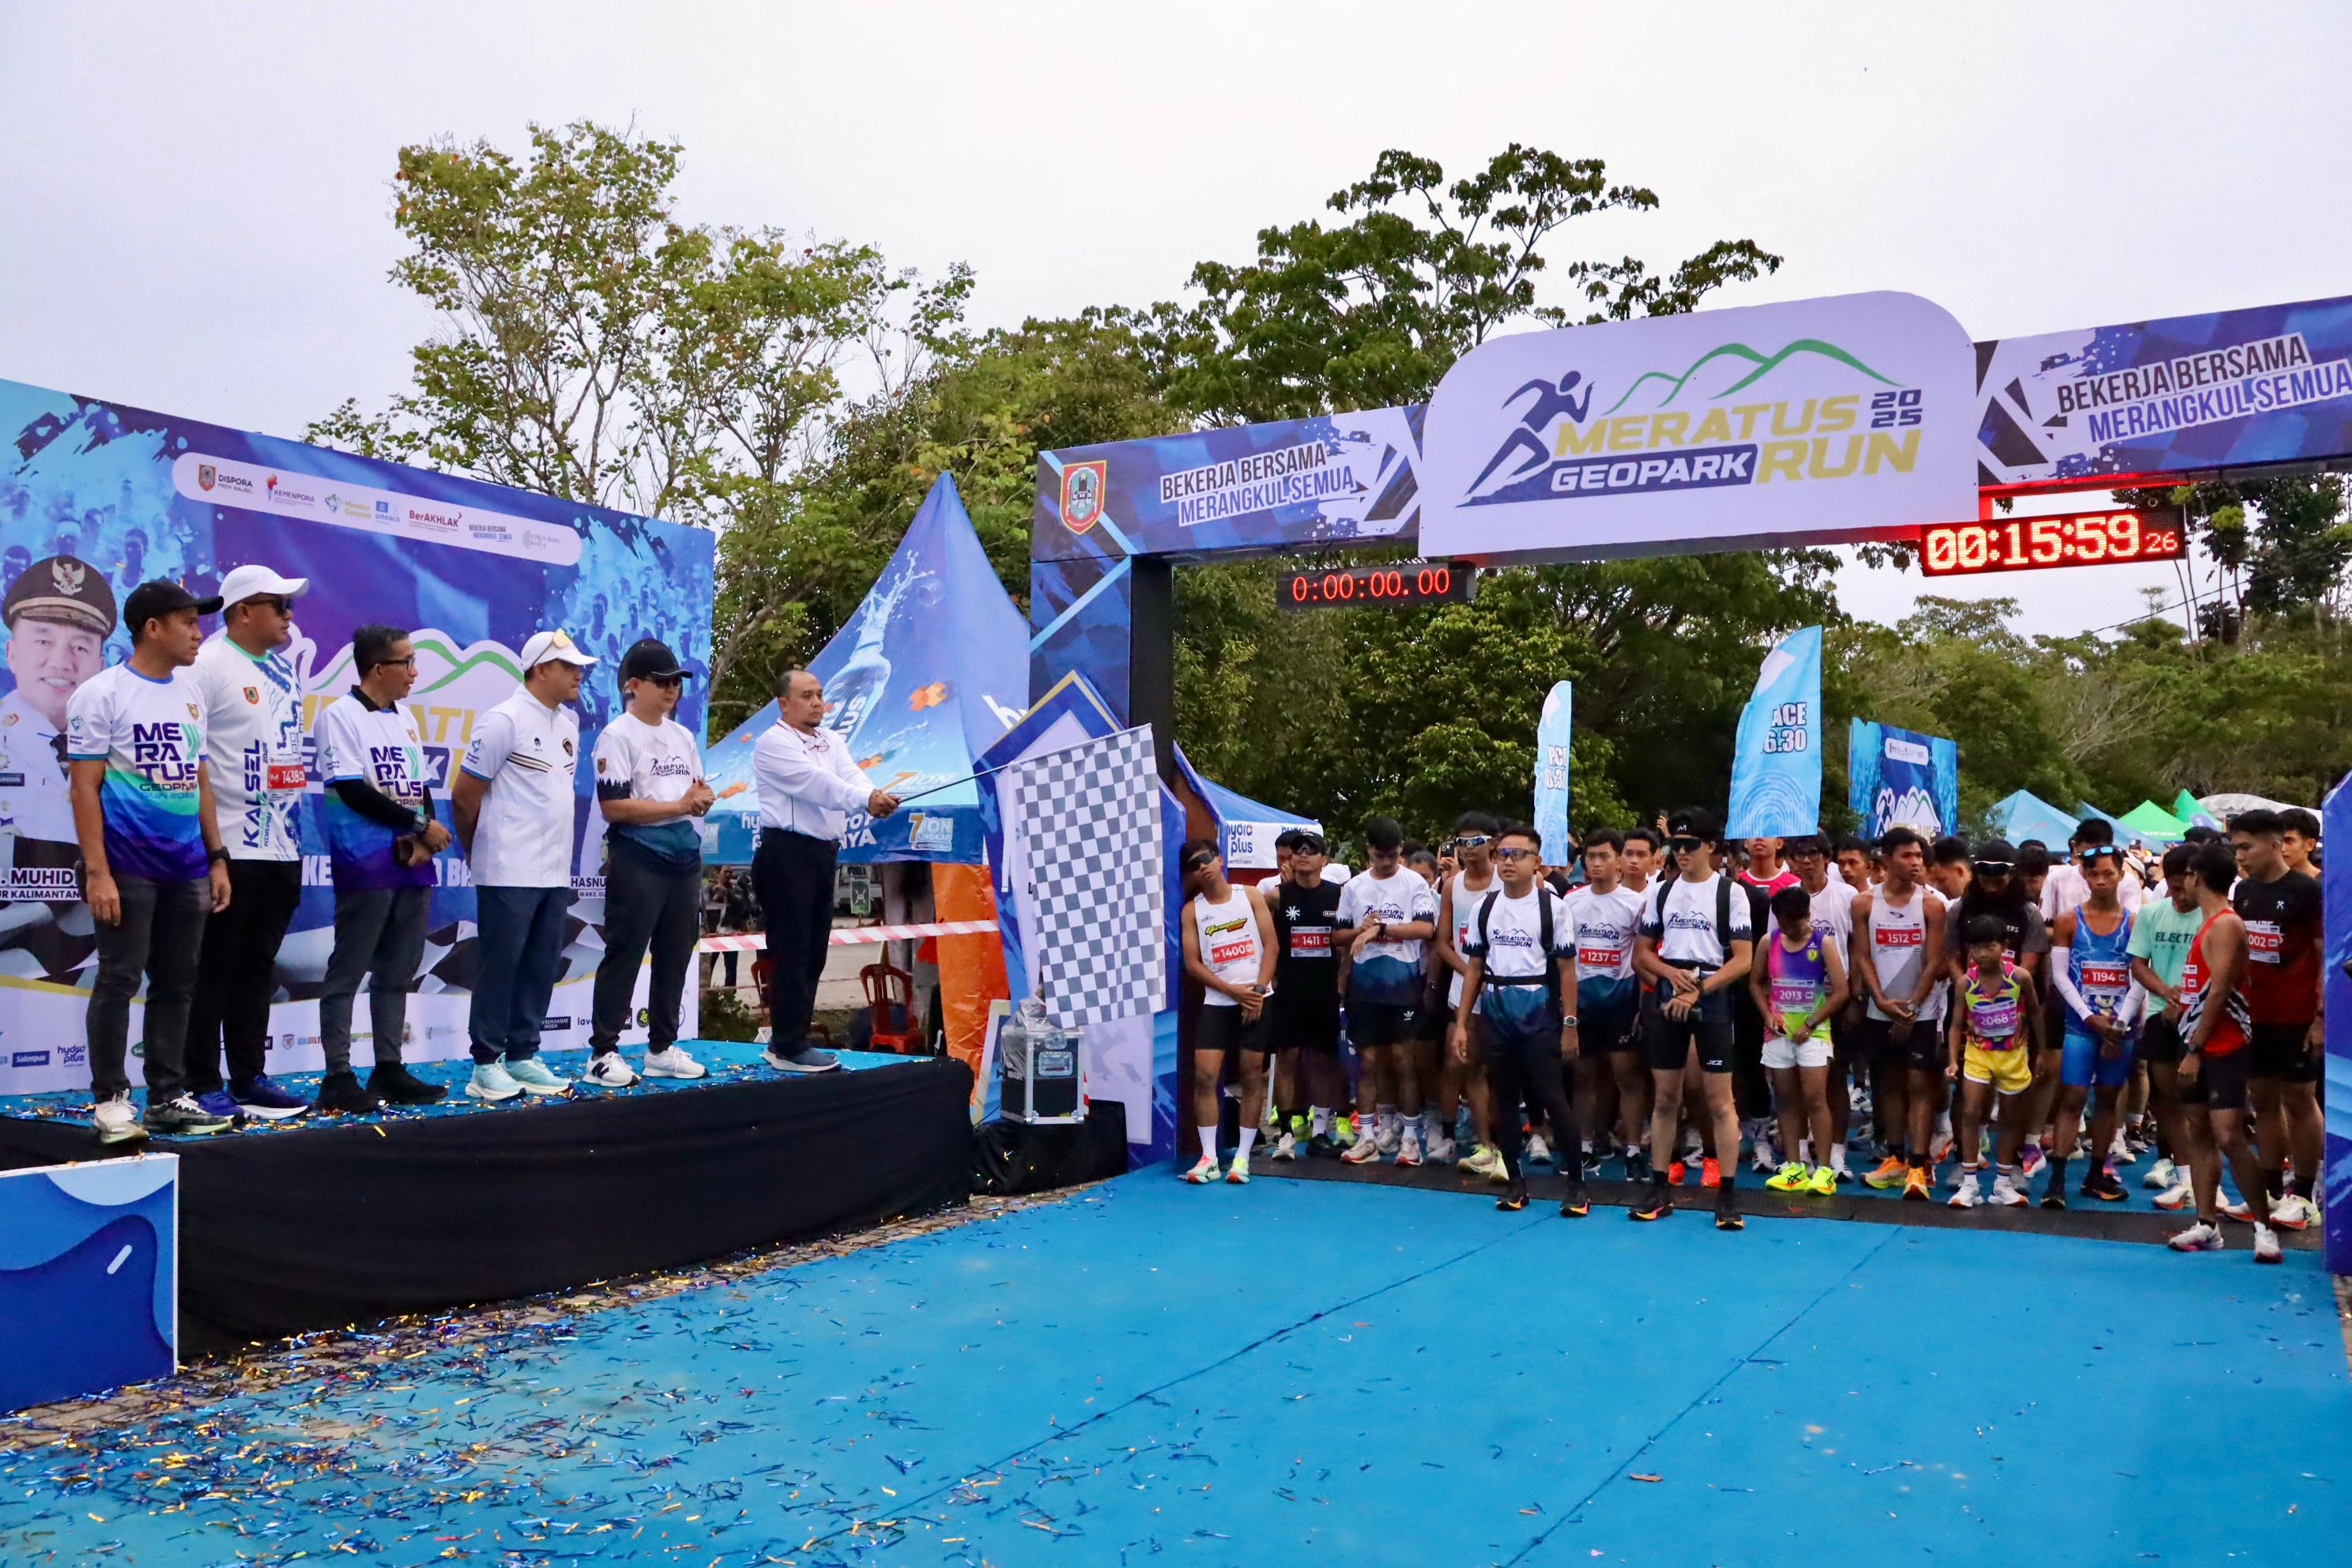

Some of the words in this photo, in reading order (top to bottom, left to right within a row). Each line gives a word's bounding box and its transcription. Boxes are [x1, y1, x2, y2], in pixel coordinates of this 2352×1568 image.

[2058, 366, 2172, 413] BEKERJA
[2177, 334, 2308, 390] BERSAMA
[1870, 389, 1922, 410] 20
[2088, 389, 2253, 444] MERANGKUL
[2256, 364, 2352, 409] SEMUA
[1554, 394, 1860, 458] MERATUS
[1870, 409, 1923, 429] 25
[1756, 428, 1920, 484] RUN
[1163, 462, 1236, 501] BEKERJA
[1241, 444, 1327, 483] BERSAMA
[1551, 452, 1752, 492] GEOPARK
[217, 474, 253, 488] DISPORA
[273, 489, 315, 503] KEMENPORA
[1180, 485, 1287, 526] MERANGKUL
[1289, 466, 1355, 501] SEMUA
[375, 514, 401, 522] unesco
[409, 510, 459, 527] BerAKHLAK
[1926, 514, 2141, 571] 00:15:59
[2144, 530, 2178, 554] 26
[133, 722, 183, 743] ME
[134, 743, 182, 763] RA
[370, 746, 405, 763] ME
[135, 763, 198, 782] TUS
[282, 770, 300, 784] 1438
[375, 763, 407, 780] RA
[243, 739, 261, 848] KALSEL
[379, 780, 423, 797] TUS
[263, 812, 273, 847] KORPRI
[1231, 839, 1253, 856] plus
[11, 870, 75, 885] MUHID
[571, 876, 606, 890] HASNU
[10, 890, 81, 899] KALIMANTAN
[1302, 936, 1320, 945] 1411
[1886, 933, 1909, 944] 1512
[2247, 934, 2267, 948] 002
[1220, 945, 1246, 958] 1400
[1587, 952, 1609, 962] 1237
[2092, 971, 2116, 982] 1194
[1780, 989, 1803, 1000] 2013
[1981, 1012, 2009, 1026] 2068
[57, 1045, 85, 1056] hydro
[63, 1054, 85, 1064] plus
